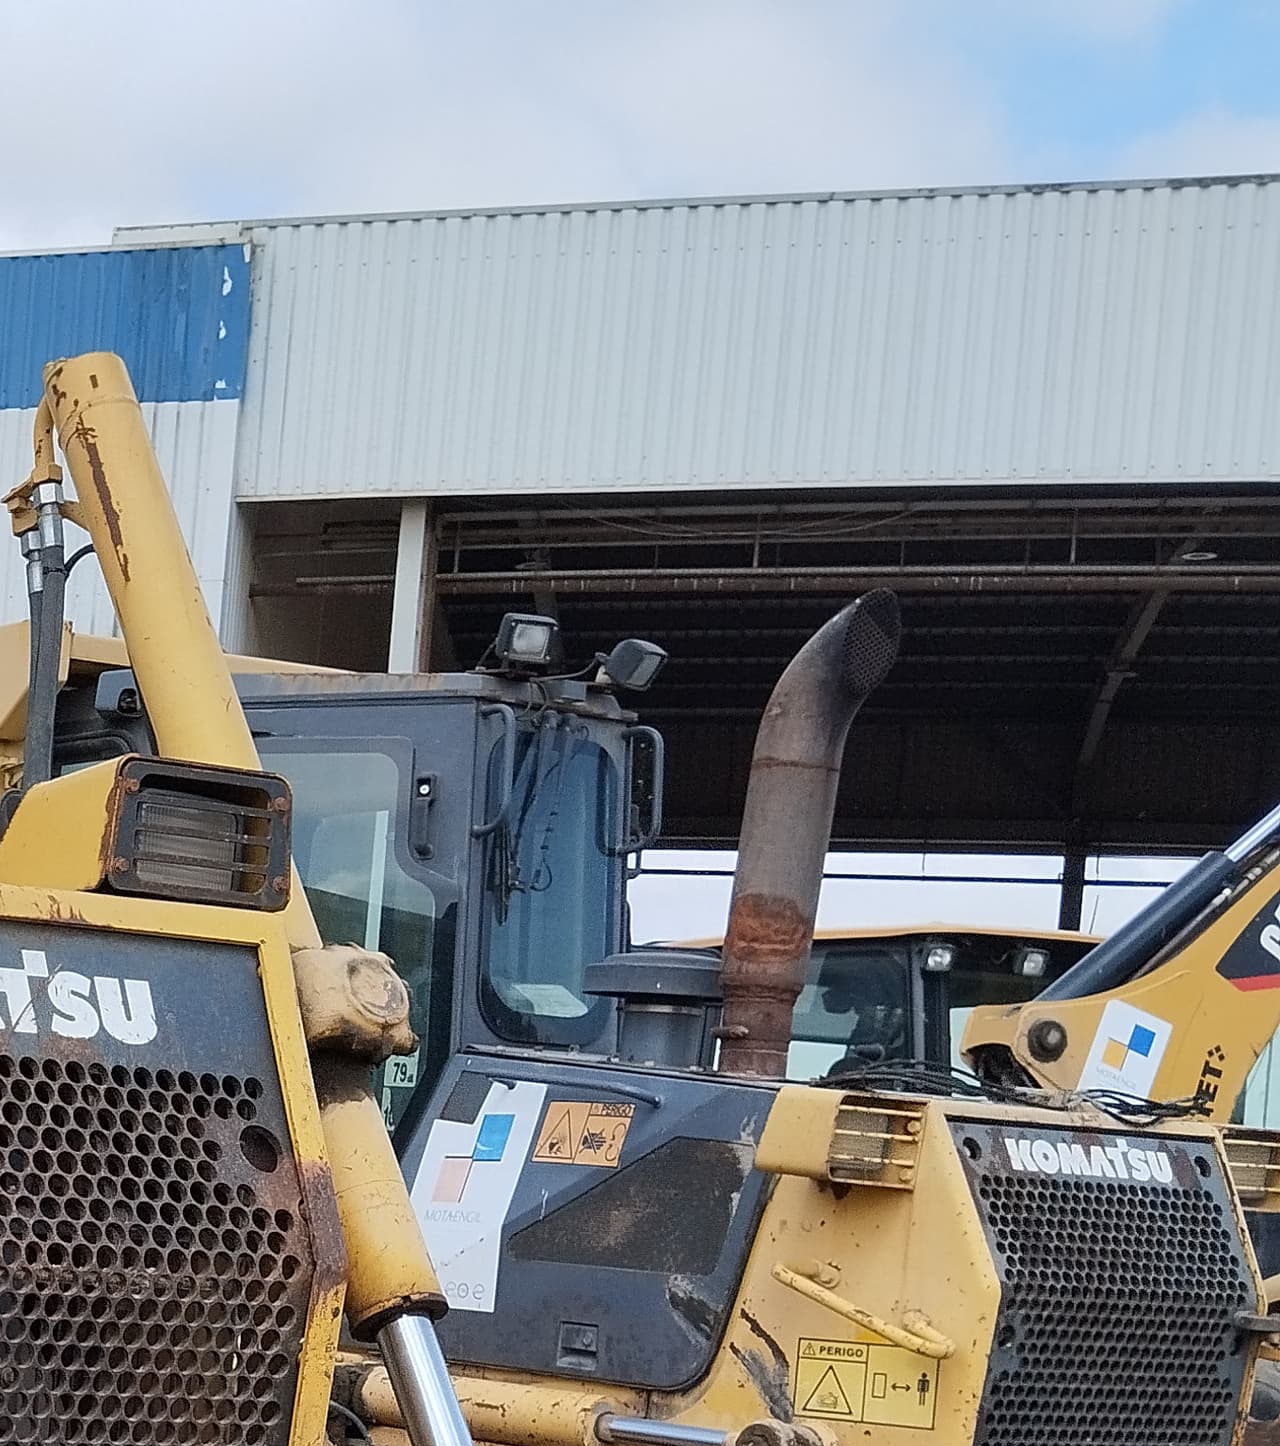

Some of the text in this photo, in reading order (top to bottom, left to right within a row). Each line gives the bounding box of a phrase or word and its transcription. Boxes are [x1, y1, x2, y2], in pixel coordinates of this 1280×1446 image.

[393, 1062, 408, 1083] 79
[1004, 1138, 1173, 1184] KOMATSU
[818, 1345, 864, 1358] PERIGO
